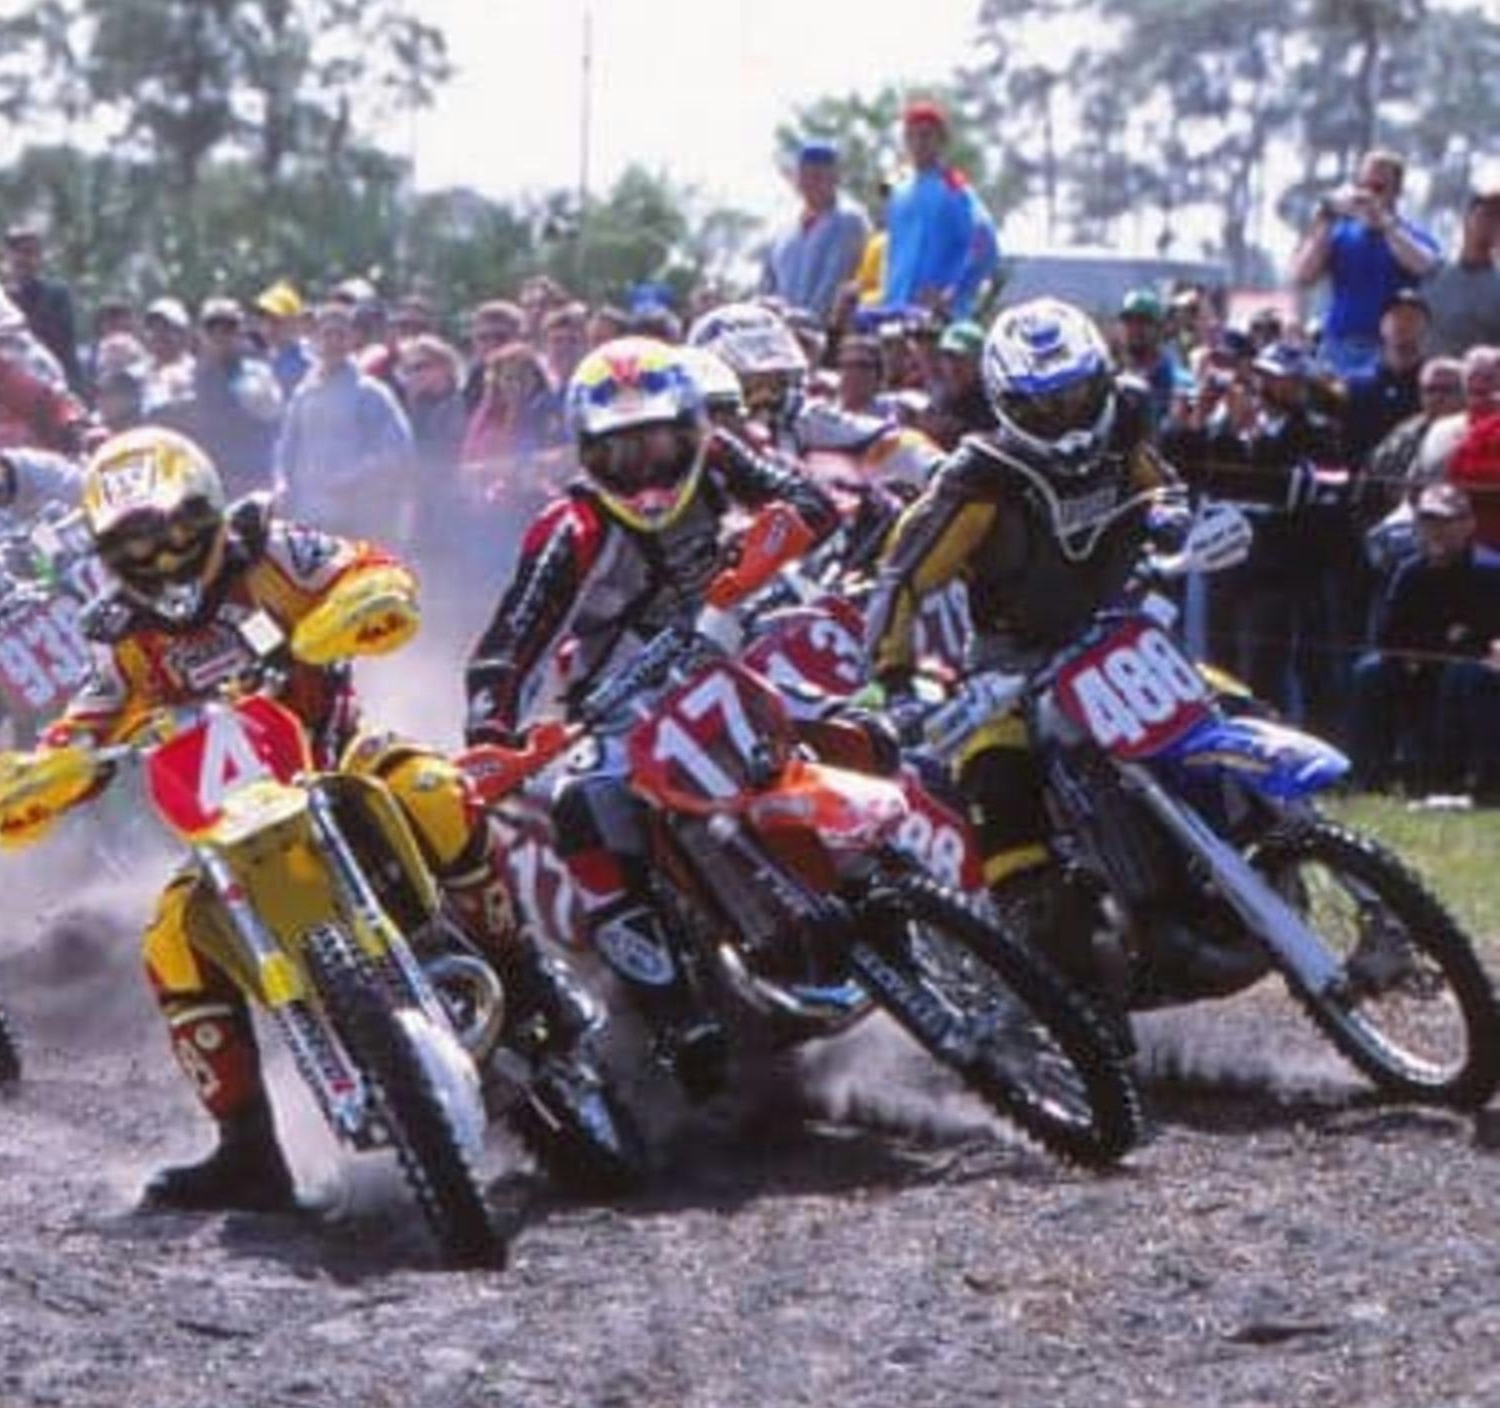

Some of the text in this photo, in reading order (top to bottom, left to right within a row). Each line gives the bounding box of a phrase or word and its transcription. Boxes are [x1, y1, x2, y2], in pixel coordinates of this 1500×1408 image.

[654, 670, 758, 798] 17
[1071, 626, 1205, 746] 488
[197, 701, 274, 821] 4
